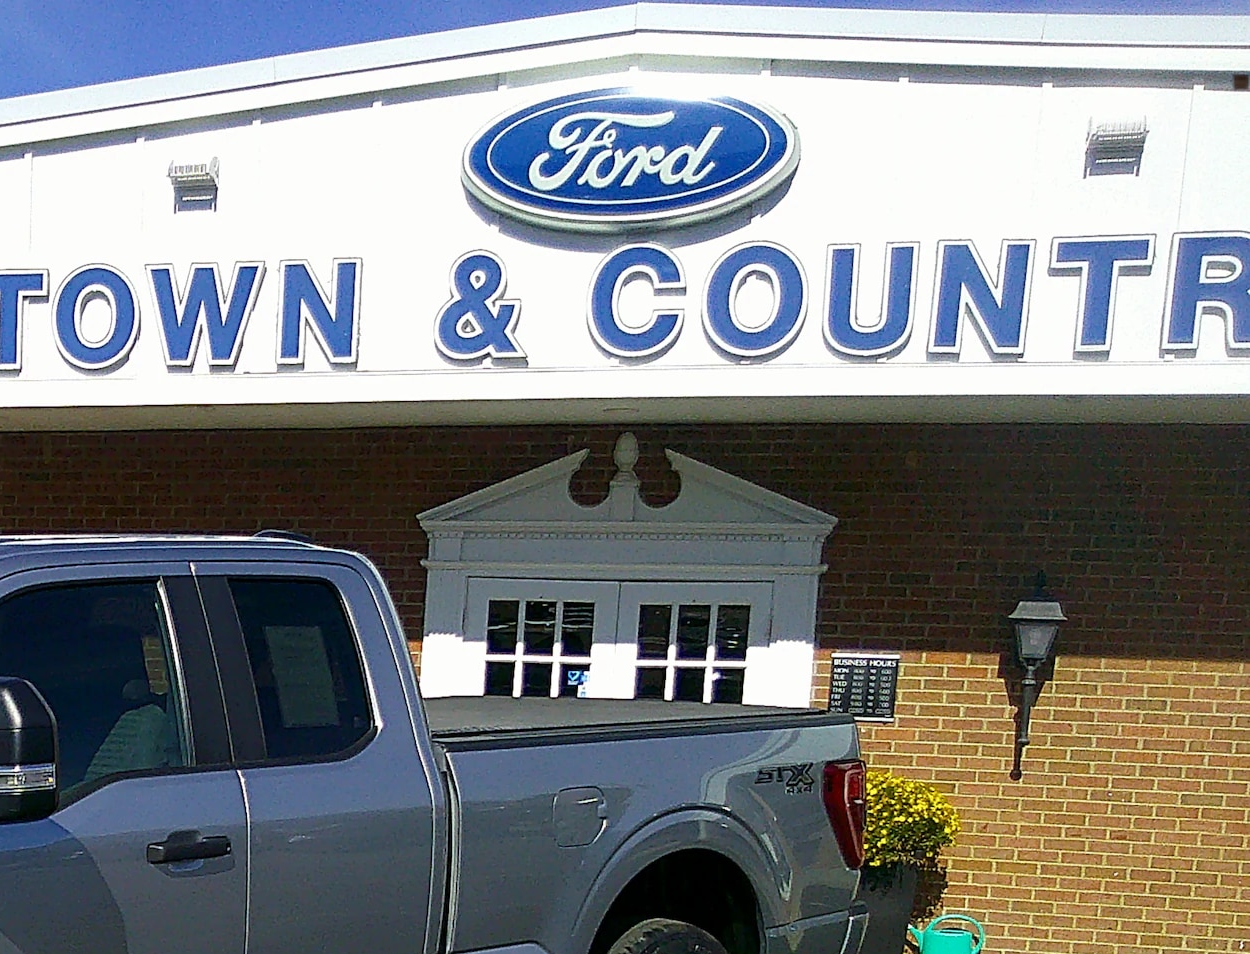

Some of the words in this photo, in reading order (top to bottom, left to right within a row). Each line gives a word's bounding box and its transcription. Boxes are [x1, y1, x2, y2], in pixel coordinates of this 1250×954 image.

[529, 111, 723, 191] Ford
[434, 250, 527, 362] &
[586, 232, 1250, 364] COUNTR
[754, 763, 814, 787] STX
